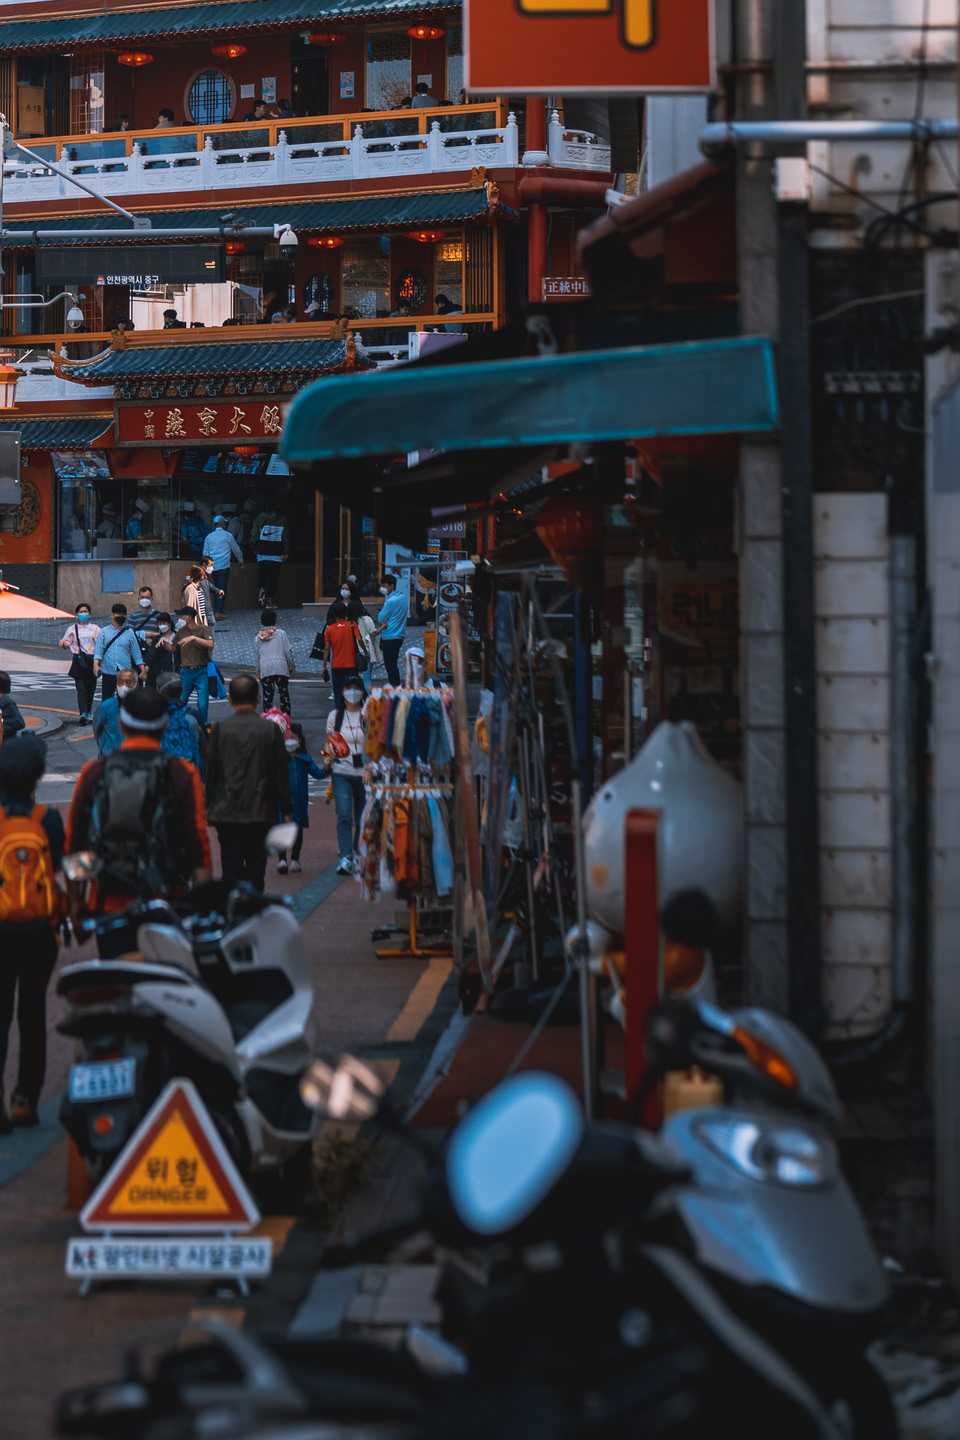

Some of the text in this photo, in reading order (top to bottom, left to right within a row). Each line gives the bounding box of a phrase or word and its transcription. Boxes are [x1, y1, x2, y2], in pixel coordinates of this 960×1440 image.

[106, 275, 159, 285] 인천광역시 중구
[128, 1187, 208, 1203] DANGER
